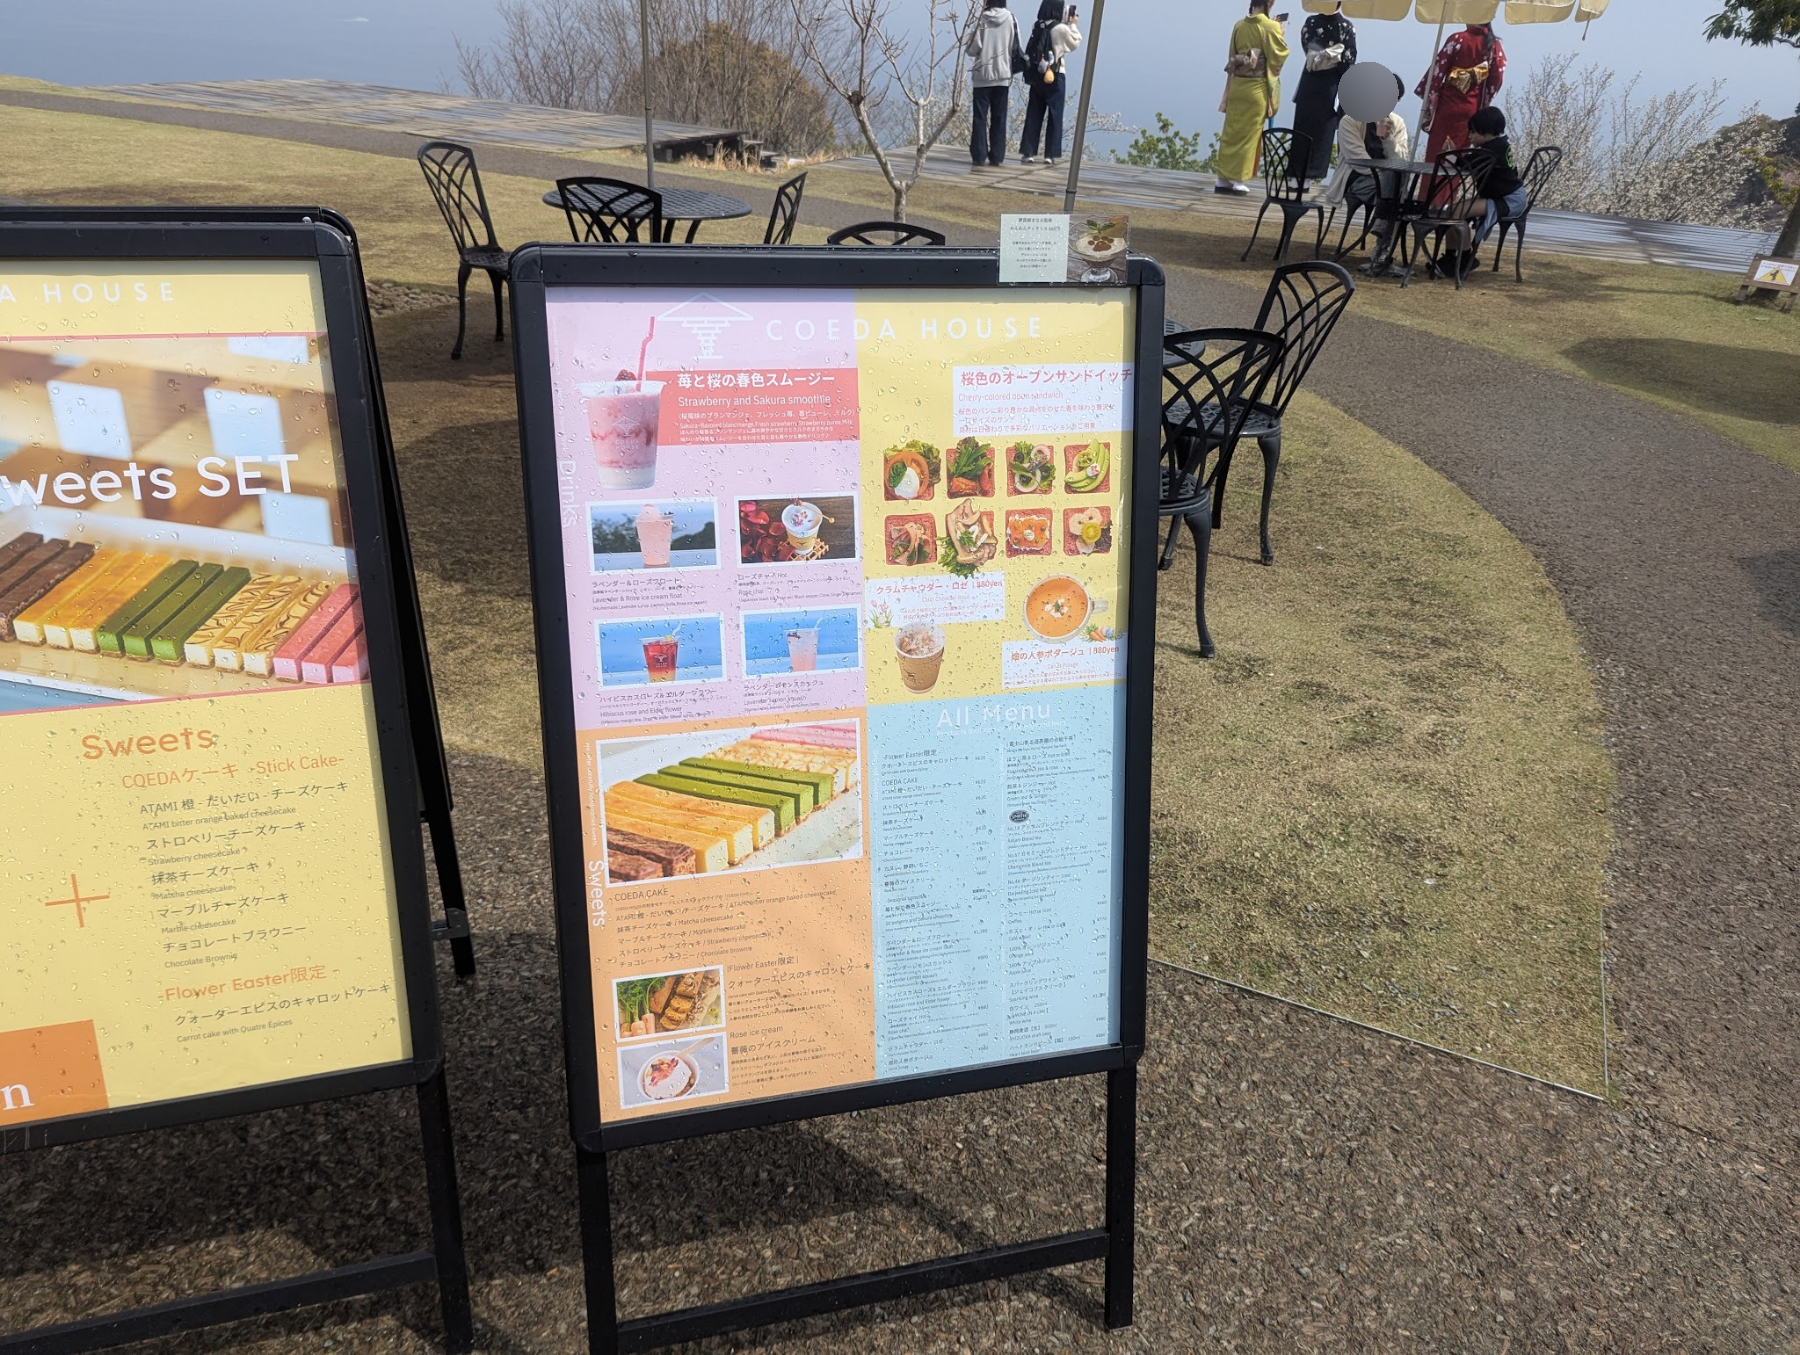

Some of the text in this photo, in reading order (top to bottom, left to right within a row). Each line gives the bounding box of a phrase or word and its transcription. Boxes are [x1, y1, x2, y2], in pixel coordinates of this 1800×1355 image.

[43, 282, 175, 303] HOUSE
[766, 317, 1040, 341] COEDA HOUSE
[677, 372, 835, 389] 苺と桜の春色スムージー
[960, 368, 1134, 387] 桜色のオープンサンドイッチ
[678, 393, 832, 408] Strawberry and Sakura smoothie
[958, 392, 1010, 403] Cherry-colored
[197, 453, 299, 498] SET
[559, 460, 577, 527] Drinks
[876, 582, 968, 595] クラムチャウダー・ロゼ
[937, 703, 1051, 728] All Menu
[82, 727, 214, 760] Sweets
[122, 763, 239, 789] COEDAケーキ
[881, 778, 901, 786] COEDA
[140, 801, 179, 815] ATAMI
[270, 781, 350, 800] チーズケーキ
[171, 818, 193, 828] bitter
[195, 814, 222, 825] orange
[250, 807, 297, 818] cheesecake
[147, 821, 307, 850] ストロベリーチーズケーキ
[148, 848, 240, 866] Strawberry cheesecake
[151, 862, 259, 886] 抹茶チーズケーキ
[186, 884, 236, 896] cheesecake
[588, 860, 605, 927] Sweets
[614, 888, 645, 902] COEDA
[646, 887, 669, 899] CAKE
[157, 892, 289, 919] マーブルチーズケーキ
[678, 917, 699, 926] Matcha
[699, 914, 734, 923] cheesecake
[162, 926, 307, 953] チョコレートブラウニー
[618, 930, 687, 944] マーブルチーズケーキ
[706, 936, 737, 947] Strawberry
[164, 950, 238, 968] Chocolate Brownie
[700, 948, 729, 958] Chocolate
[232, 965, 327, 992] Easter限定
[177, 1032, 201, 1043] Carrot
[202, 1030, 221, 1040] cake
[222, 1027, 239, 1036] with
[240, 1022, 267, 1034] Quatre
[730, 1031, 748, 1039] Rose
[760, 1025, 784, 1034] cream
